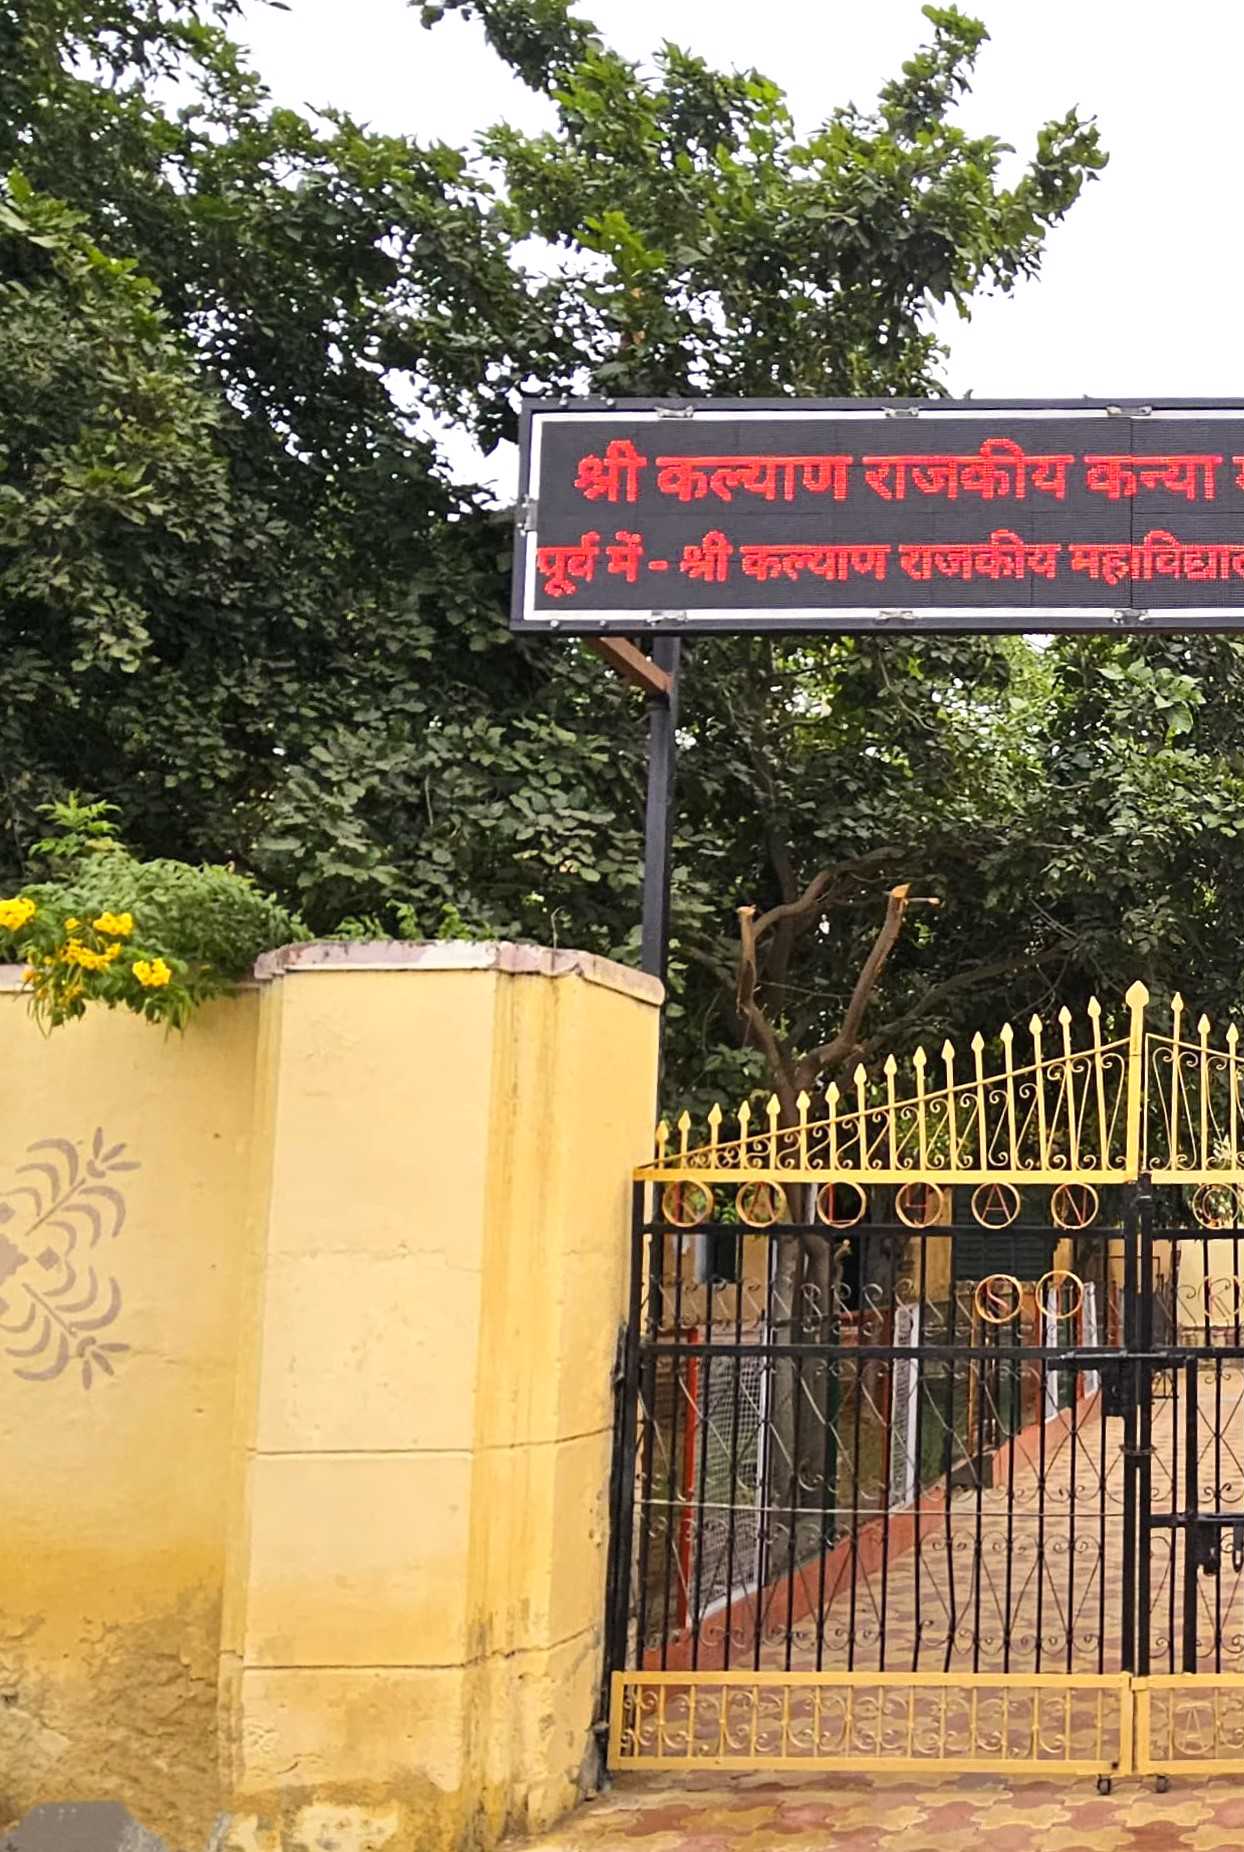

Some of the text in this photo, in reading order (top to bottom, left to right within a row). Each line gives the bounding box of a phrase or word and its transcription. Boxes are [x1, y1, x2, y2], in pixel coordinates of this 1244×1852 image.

[574, 439, 648, 503] श्री
[655, 454, 853, 502] कल्याण
[861, 438, 1075, 501] राजकीय
[1082, 454, 1223, 501] कन्या
[537, 529, 599, 597] पूर्व
[606, 530, 645, 582] में
[679, 529, 734, 583] श्री
[739, 543, 893, 582] कल्याण
[897, 529, 1062, 580] राजकीय
